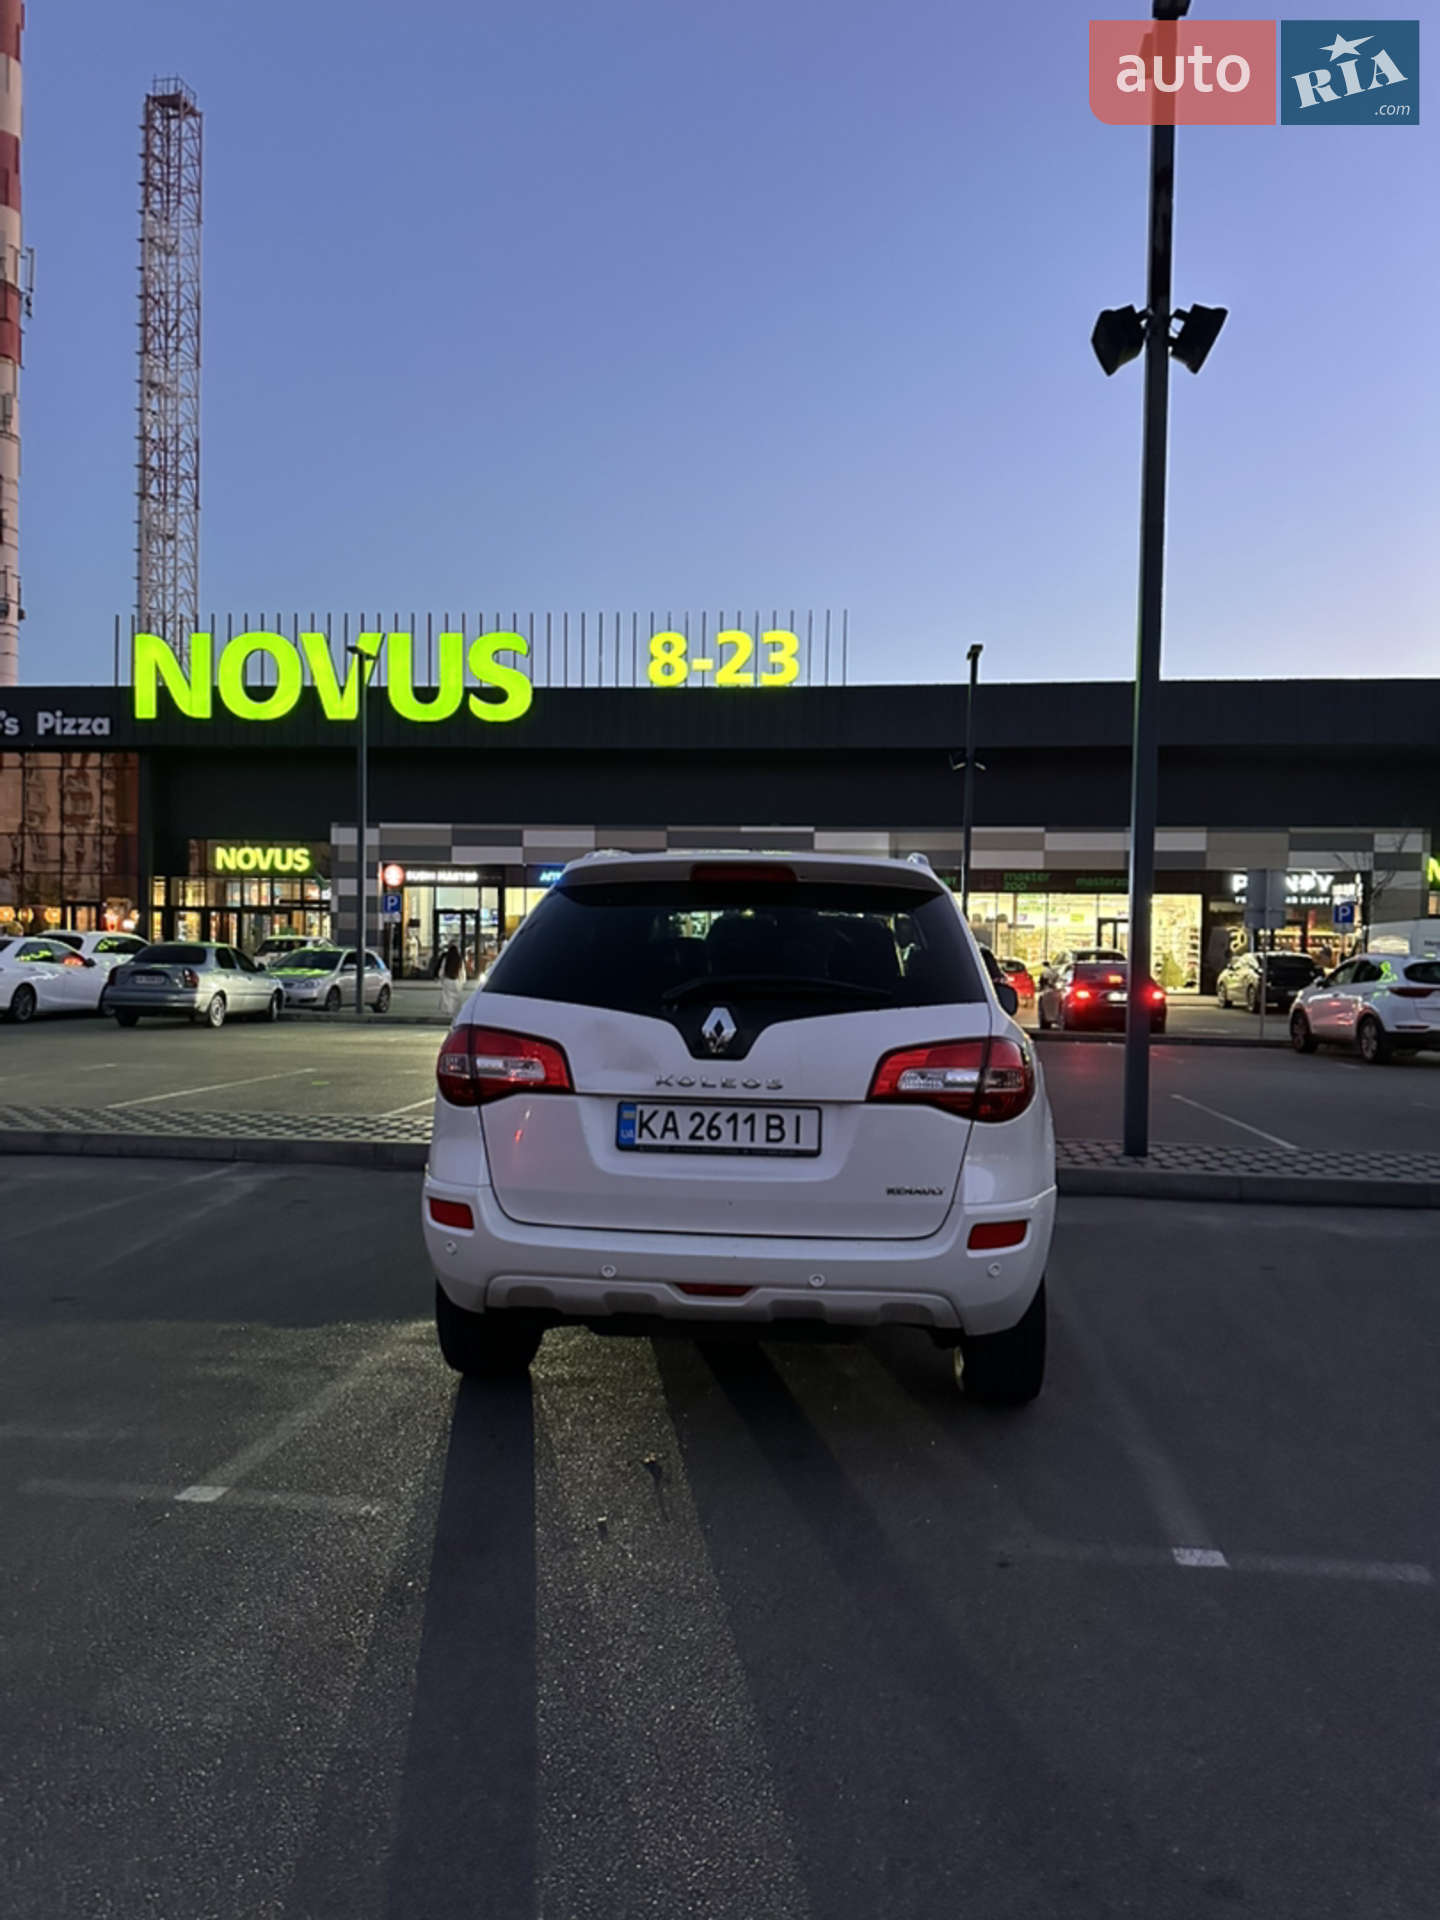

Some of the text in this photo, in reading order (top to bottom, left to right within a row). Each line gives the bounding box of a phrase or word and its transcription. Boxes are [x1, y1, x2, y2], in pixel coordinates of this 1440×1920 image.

[648, 630, 800, 687] 8-23
[134, 631, 533, 722] NOVUS
[37, 710, 111, 735] Pizza
[216, 846, 311, 872] NOVUS
[1004, 872, 1050, 882] master
[1076, 876, 1129, 887] masterzo
[656, 1074, 783, 1090] KOLEOS
[637, 1109, 680, 1139] KA
[688, 1111, 756, 1142] 2611
